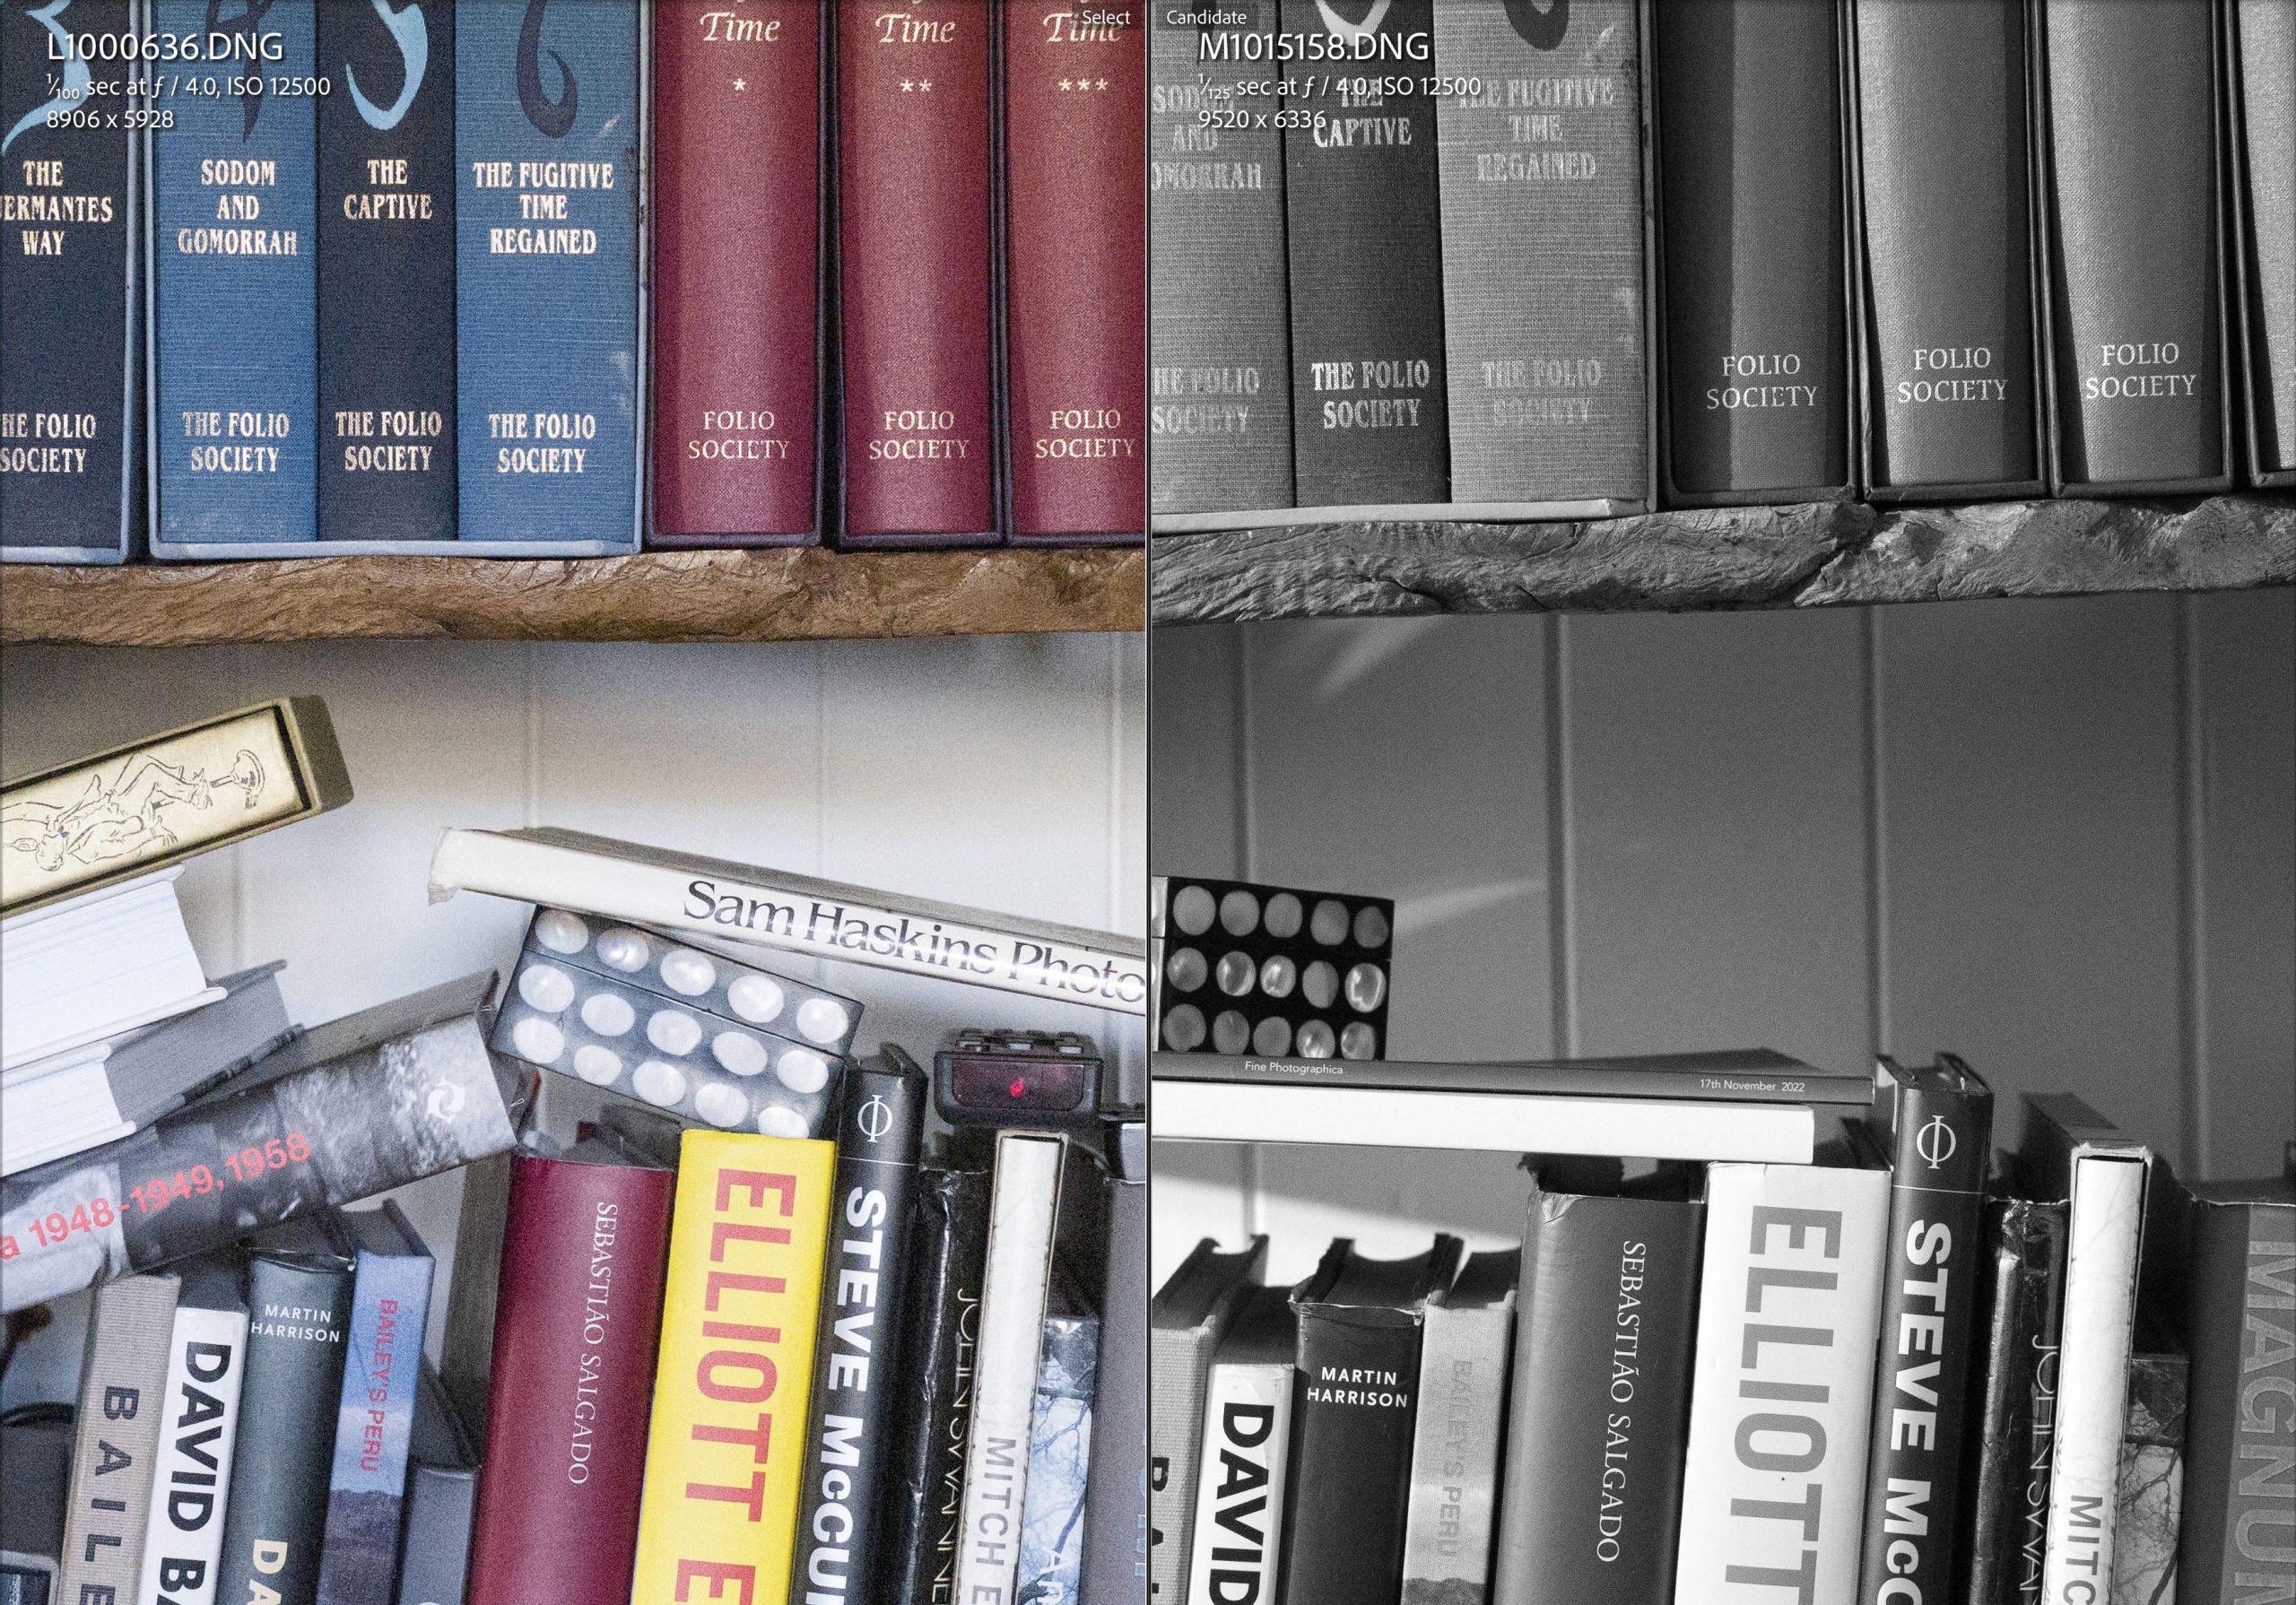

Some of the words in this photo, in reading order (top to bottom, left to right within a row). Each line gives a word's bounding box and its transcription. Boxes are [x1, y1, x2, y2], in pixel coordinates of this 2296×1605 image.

[700, 12, 780, 43] Time
[875, 13, 955, 44] Time
[1314, 117, 1412, 147] CAPTIVE
[1509, 115, 1562, 142] TIME
[23, 160, 63, 187] THE
[201, 160, 275, 186] SODOM
[368, 159, 407, 185] THE
[474, 162, 513, 187] THE
[518, 162, 613, 189] FUGITIVE
[217, 195, 259, 220] AND
[344, 195, 432, 220] CAPTIVE
[520, 195, 567, 220] TIME
[22, 231, 65, 256] WAY
[178, 230, 297, 256] GOMORRAH
[490, 230, 596, 255] REGAINED
[1722, 354, 1801, 377] FOLIO
[1914, 348, 1991, 370] FOLIO
[2101, 343, 2179, 366] FOLIO
[1311, 362, 1354, 391] THE
[1361, 360, 1431, 389] FOLIO
[2086, 375, 2196, 401] SOCIETY
[1707, 386, 1818, 410] SOCIETY
[1897, 378, 2009, 403] SOCIETY
[36, 413, 96, 438] FOLIO
[183, 412, 222, 437] THE
[228, 412, 289, 438] FOLIO
[335, 411, 376, 437] THE
[380, 411, 442, 437] FOLIO
[489, 413, 529, 438] THE
[534, 413, 596, 439] FOLIO
[703, 412, 775, 430] FOLIO
[884, 411, 954, 430] FOLIO
[1050, 410, 1121, 429] FOLIO
[1323, 398, 1421, 429] SOCIETY
[0, 447, 86, 473] SOCIETY
[190, 447, 280, 473] SOCIETY
[344, 446, 433, 472] SOCIETY
[497, 448, 586, 473] SOCIETY
[689, 439, 790, 460] SOCIETY
[869, 439, 969, 460] SOCIETY
[1035, 438, 1135, 458] SOCIETY
[683, 880, 796, 937] Sam
[805, 901, 997, 975] Haskins
[1008, 941, 1147, 1002] Photo
[1245, 1061, 1266, 1071] Fine
[1269, 1062, 1344, 1075] Photographica
[1700, 1079, 1721, 1089] 17th
[1724, 1080, 1776, 1090] November
[1781, 1081, 1805, 1092] 2022
[29, 1164, 224, 1247] 1948-1949,
[224, 1132, 310, 1182] 1958
[582, 1202, 618, 1346] SEBASTIÃO
[829, 1186, 887, 1392] STEVE
[265, 1305, 332, 1323] MARTIN
[1610, 1240, 1647, 1404] SEBASTIÃO
[251, 1323, 340, 1342] HARRISON
[685, 1168, 796, 1522] ELLIOTT
[1890, 1219, 1952, 1452] STEVE
[1321, 1366, 1397, 1386] MARTIN
[1308, 1387, 1408, 1409] HARRISON
[1725, 1205, 1843, 1605] ELLIOTT
[568, 1353, 601, 1485] SALGADO
[167, 1341, 231, 1532] DAVID
[361, 1410, 385, 1473] PERU
[976, 1436, 1016, 1565] MITCH
[1596, 1413, 1631, 1563] SALGADO
[806, 1414, 864, 1605] McCU
[1209, 1401, 1275, 1605] DAVID
[1436, 1486, 1463, 1557] PERU
